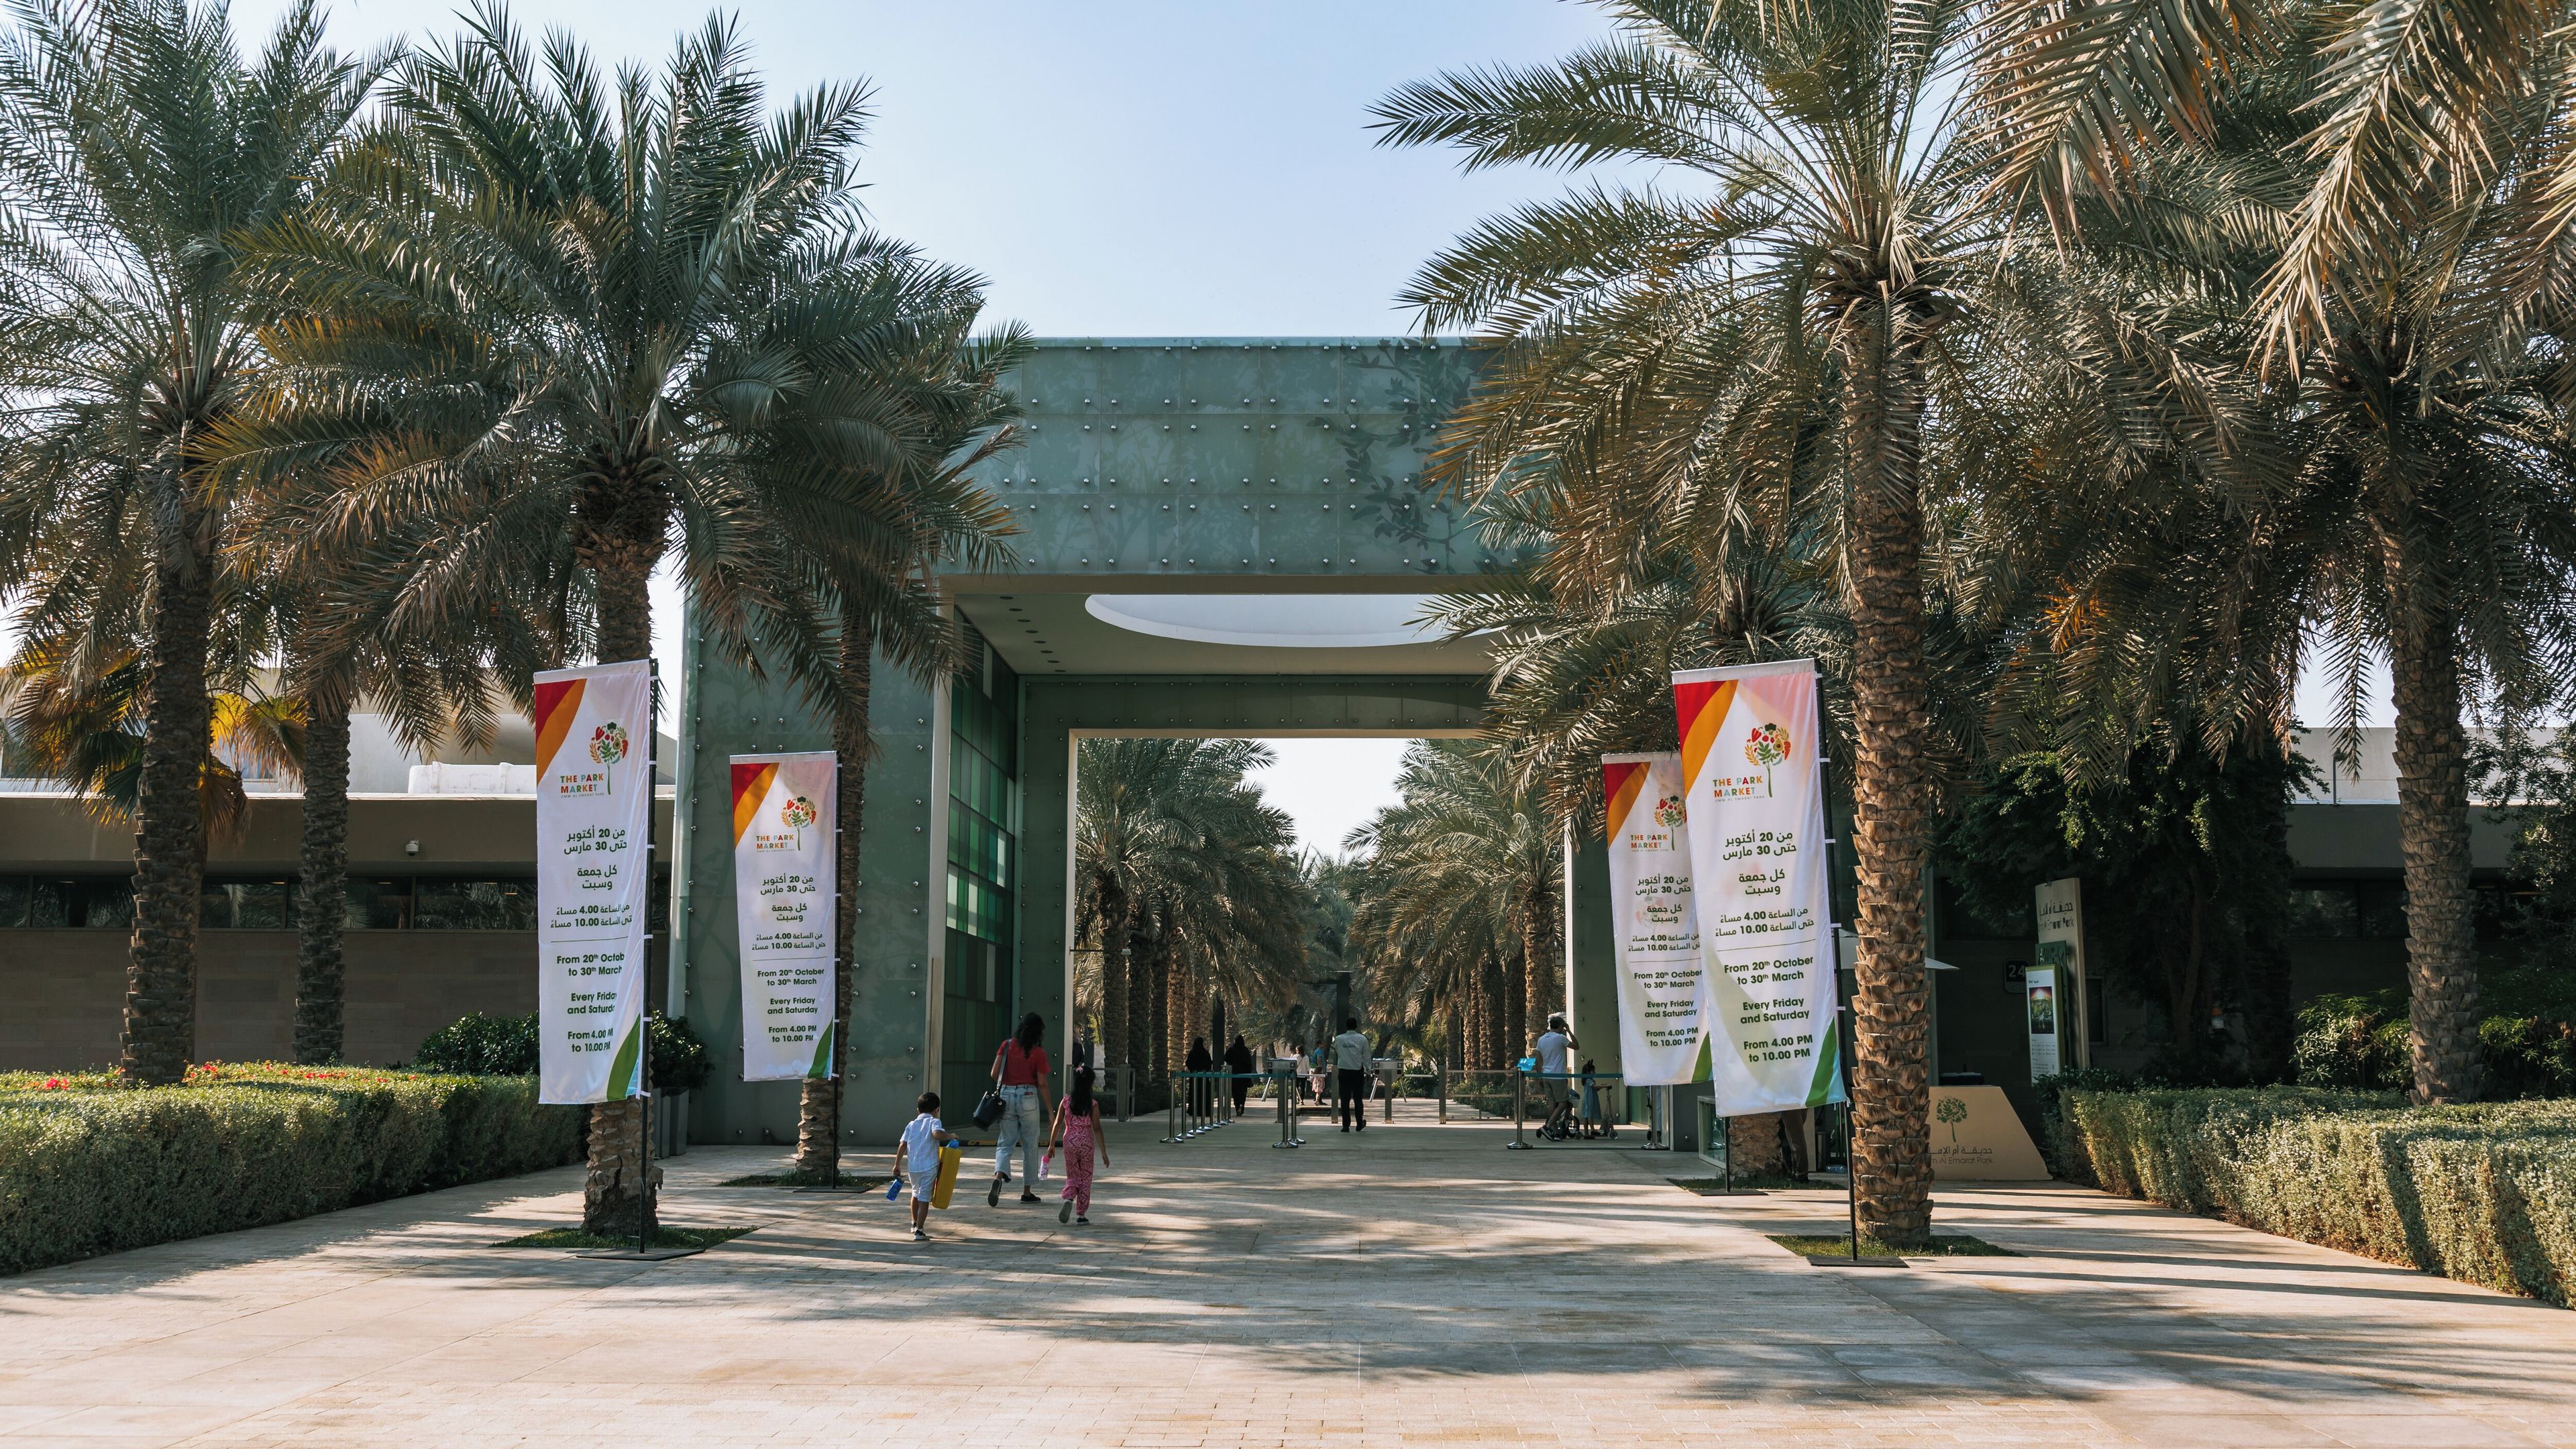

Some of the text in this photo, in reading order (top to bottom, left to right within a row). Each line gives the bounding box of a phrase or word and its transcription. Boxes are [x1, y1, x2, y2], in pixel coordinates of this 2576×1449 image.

[581, 773, 603, 782] PARK
[1713, 775, 1762, 787] THE PARK
[561, 784, 597, 793] MARKET
[1714, 787, 1755, 798] MARKET
[567, 824, 625, 842] من 20 أكتوبر
[1725, 829, 1792, 847] من 20 أكتوبر
[564, 841, 591, 855] مارس
[596, 841, 606, 850] 30
[1723, 843, 1796, 860] حتى 30 مارس
[578, 865, 617, 877] كل جمعة
[1739, 869, 1784, 883] كل جمعة
[763, 873, 786, 885] أكتوبر
[1638, 873, 1660, 885] أكتوبر
[582, 880, 612, 890] وسبت
[761, 885, 784, 895] مارس
[800, 885, 815, 894] حتى
[1635, 885, 1658, 895] مارس
[1674, 885, 1690, 894] حتى
[1746, 885, 1780, 896] وسبت
[580, 906, 598, 914] 4.00
[622, 904, 630, 912] من
[796, 903, 807, 912] كل
[1647, 904, 1682, 914] كل جمعة
[1796, 908, 1808, 916] من
[1744, 911, 1766, 920] 4.00
[1769, 908, 1795, 918] الساعة
[575, 918, 599, 926] 10.00
[621, 915, 632, 925] تى
[1652, 915, 1678, 923] وسبت
[1740, 924, 1768, 934] 10.00
[1770, 921, 1796, 931] الساعة
[1798, 919, 1814, 930] حتى
[557, 953, 625, 964] From 20th Octob
[1724, 957, 1813, 973] From 20th October
[568, 965, 622, 976] to 30th March
[1671, 969, 1703, 978] October
[1737, 971, 1804, 985] to 30th March
[571, 993, 594, 1002] Every
[568, 1004, 614, 1014] and Saturd
[1743, 998, 1804, 1010] Every Friday
[1662, 1009, 1697, 1017] Saturday
[1740, 1010, 1809, 1024] and Saturday
[591, 1030, 606, 1038] 4.00
[1744, 1034, 1813, 1050] From 4.00 PM
[572, 1044, 581, 1052] to
[585, 1043, 602, 1051] 10.00
[1749, 1048, 1810, 1062] to 10.00 PM
[1952, 1145, 1959, 1157] أم
[1962, 1146, 1992, 1156] حديقة
